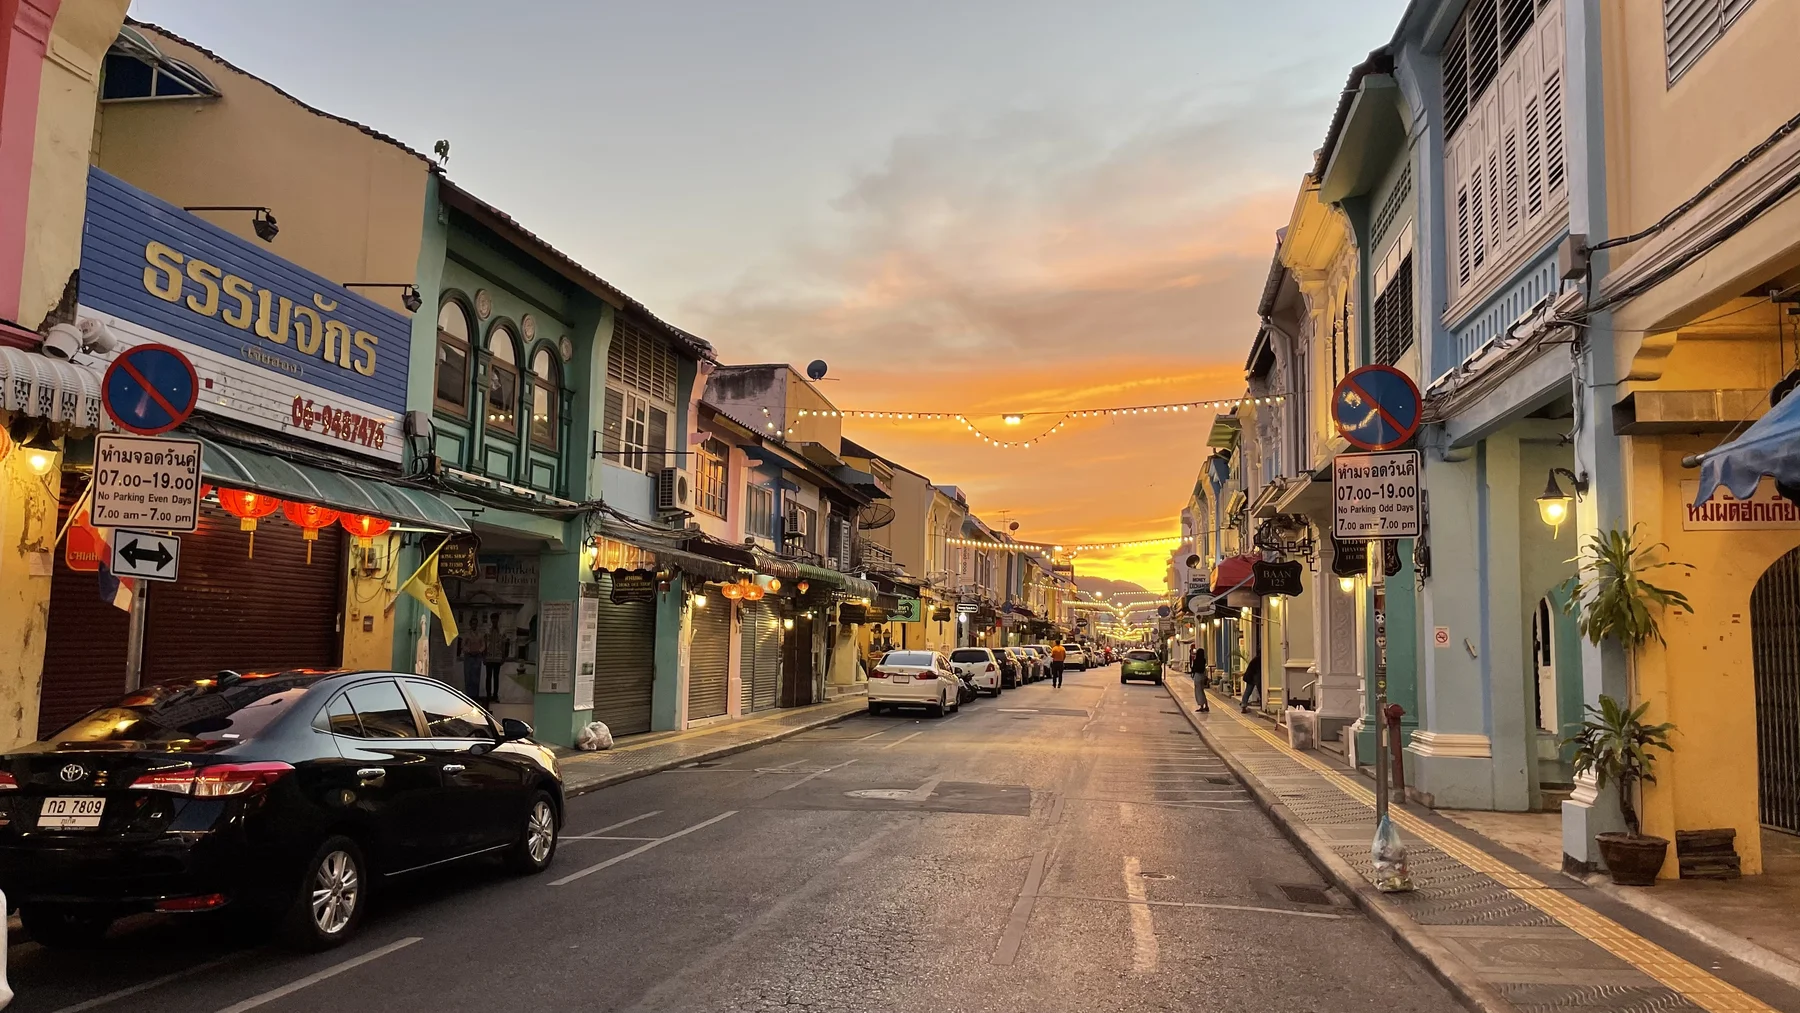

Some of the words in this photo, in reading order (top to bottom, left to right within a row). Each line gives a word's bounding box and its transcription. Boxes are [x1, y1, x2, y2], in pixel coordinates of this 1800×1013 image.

[143, 241, 379, 377] ธรรมจักร
[101, 444, 197, 474] ห้ามจอดวันคู่
[1338, 454, 1415, 480] ห้ามจอดวันคี่
[99, 469, 194, 490] 07.00-19.00
[98, 491, 110, 500] No
[113, 492, 145, 504] Parking
[148, 493, 168, 503] Even
[171, 495, 192, 506] Days
[1338, 483, 1415, 501] 07.00-19.00
[97, 505, 120, 519] 7.00
[175, 514, 191, 523] pm
[1338, 506, 1348, 514] No
[1350, 505, 1376, 514] Parking
[1379, 504, 1394, 513] Odd
[1397, 504, 1414, 513] Days
[1338, 518, 1357, 531] 7.00
[1401, 521, 1416, 530] pm
[496, 561, 536, 574] Phuket
[1263, 570, 1291, 578] BAAN
[1271, 579, 1285, 587] 125
[47, 800, 67, 813] กอ
[71, 800, 102, 813] 7809
